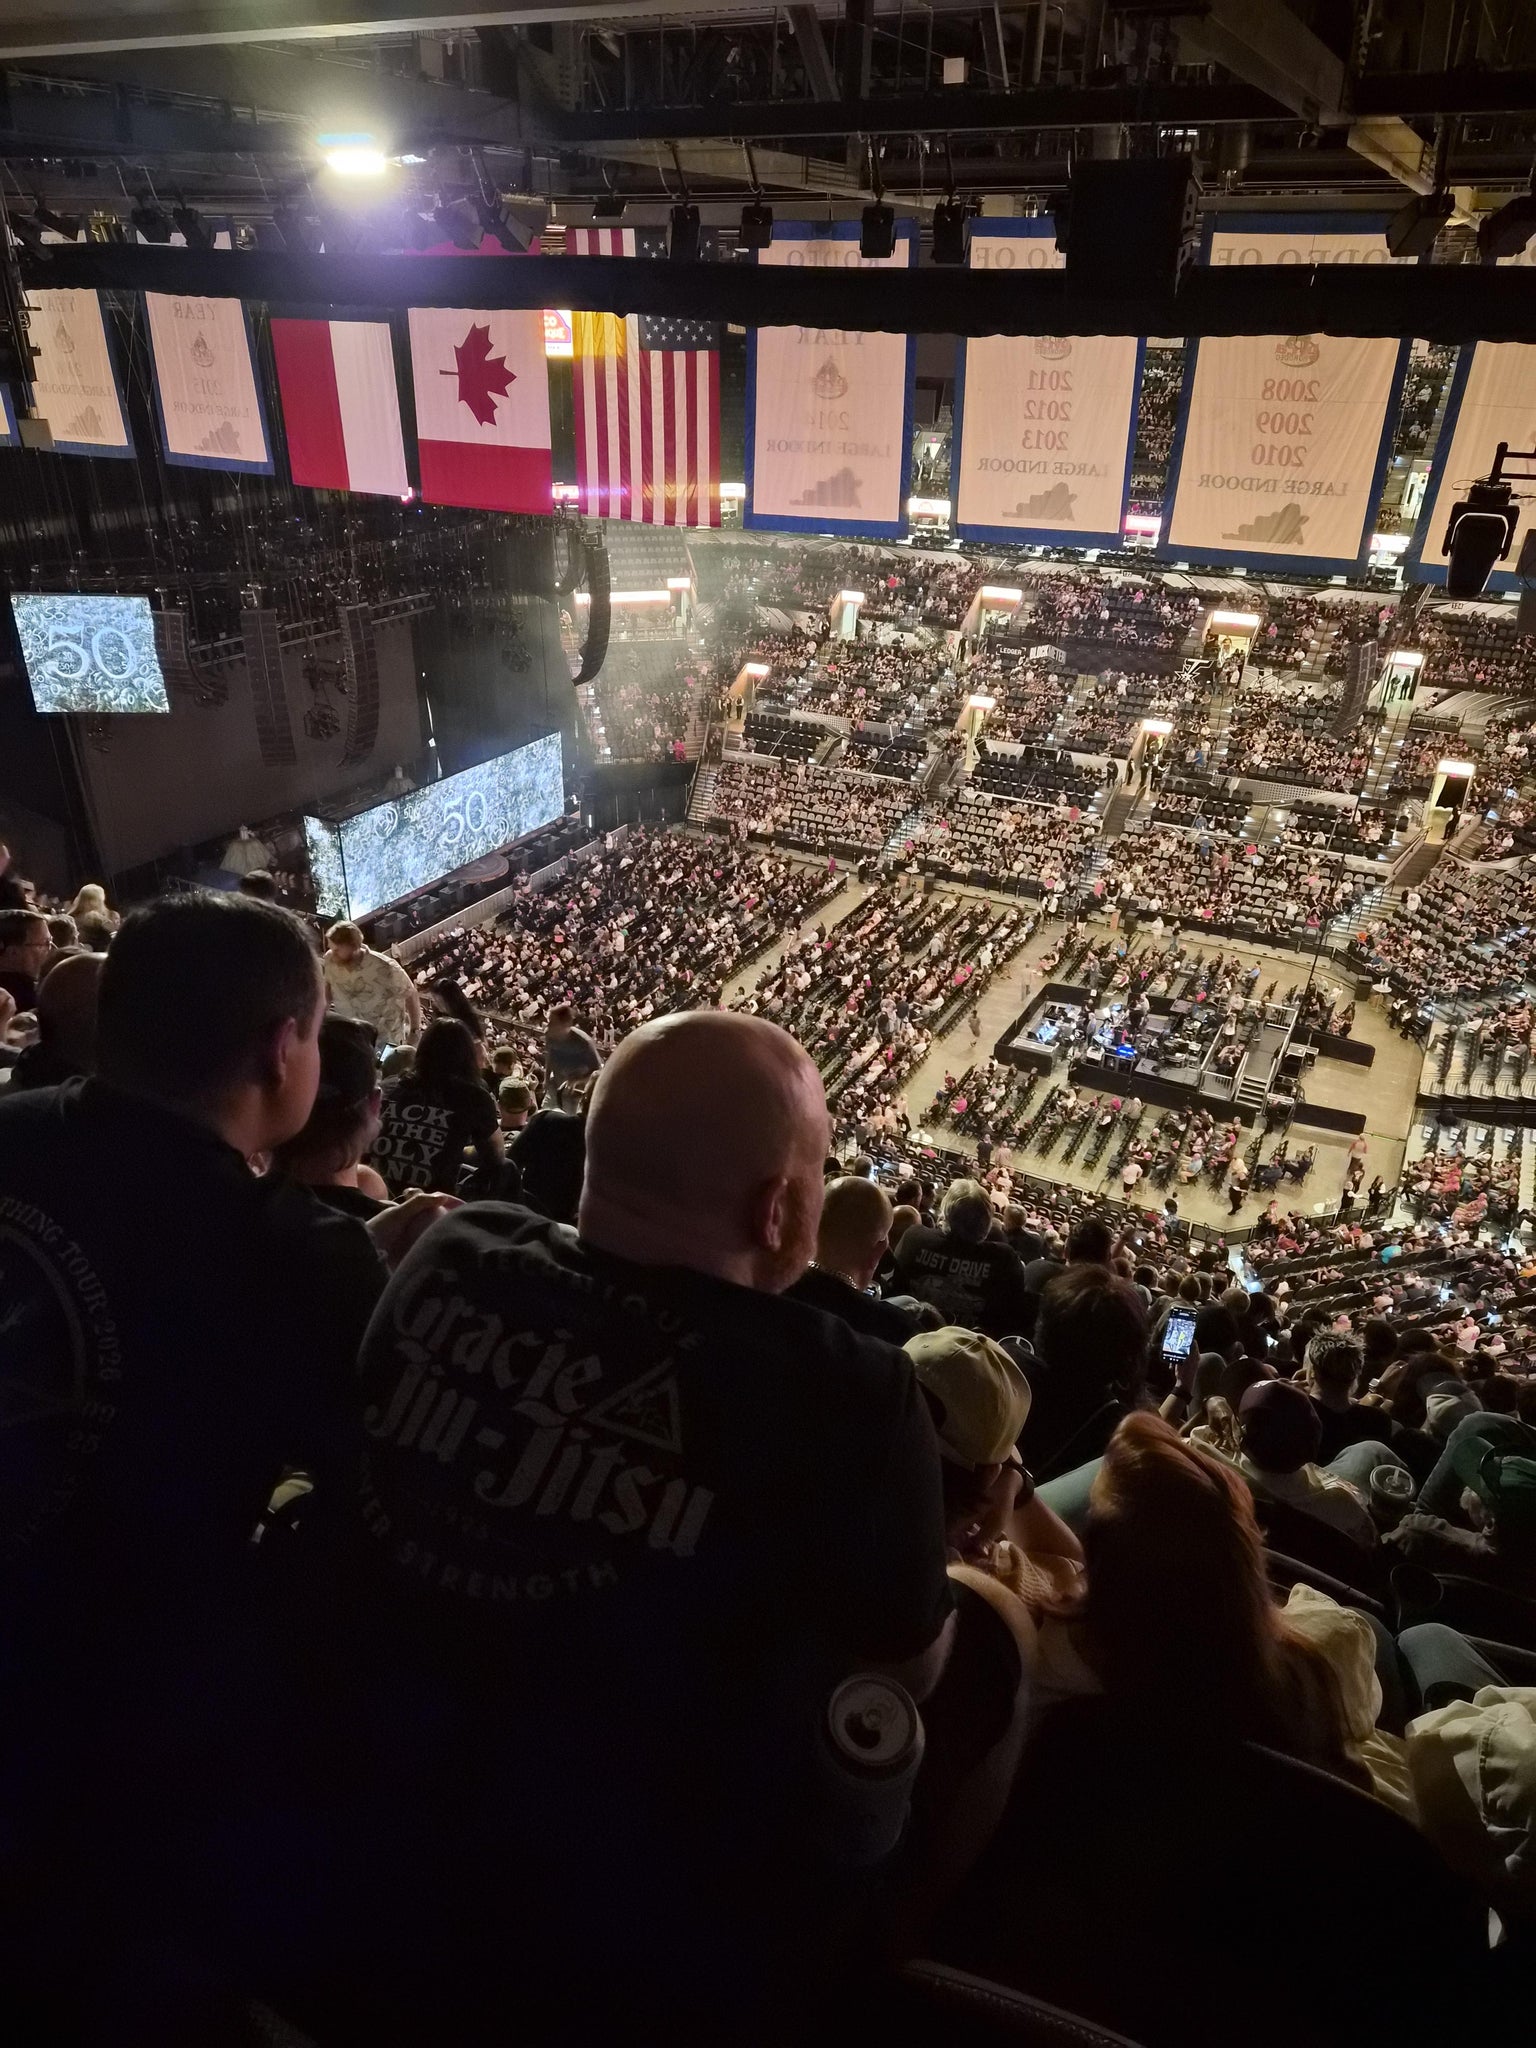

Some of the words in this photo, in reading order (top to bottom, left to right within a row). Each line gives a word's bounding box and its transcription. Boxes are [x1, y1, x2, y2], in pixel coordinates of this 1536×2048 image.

[39, 622, 138, 680] 50
[999, 647, 1022, 656] LEDGER
[442, 790, 488, 844] 50
[381, 1100, 455, 1129] ACK
[389, 1121, 449, 1147] THE
[373, 1136, 442, 1166] OLY
[58, 1241, 108, 1314] TOUR
[915, 1249, 949, 1271] JUST
[950, 1258, 992, 1279] DRIVE
[393, 1264, 603, 1414] Gracie
[362, 1340, 716, 1559] Jiu-Jitsu
